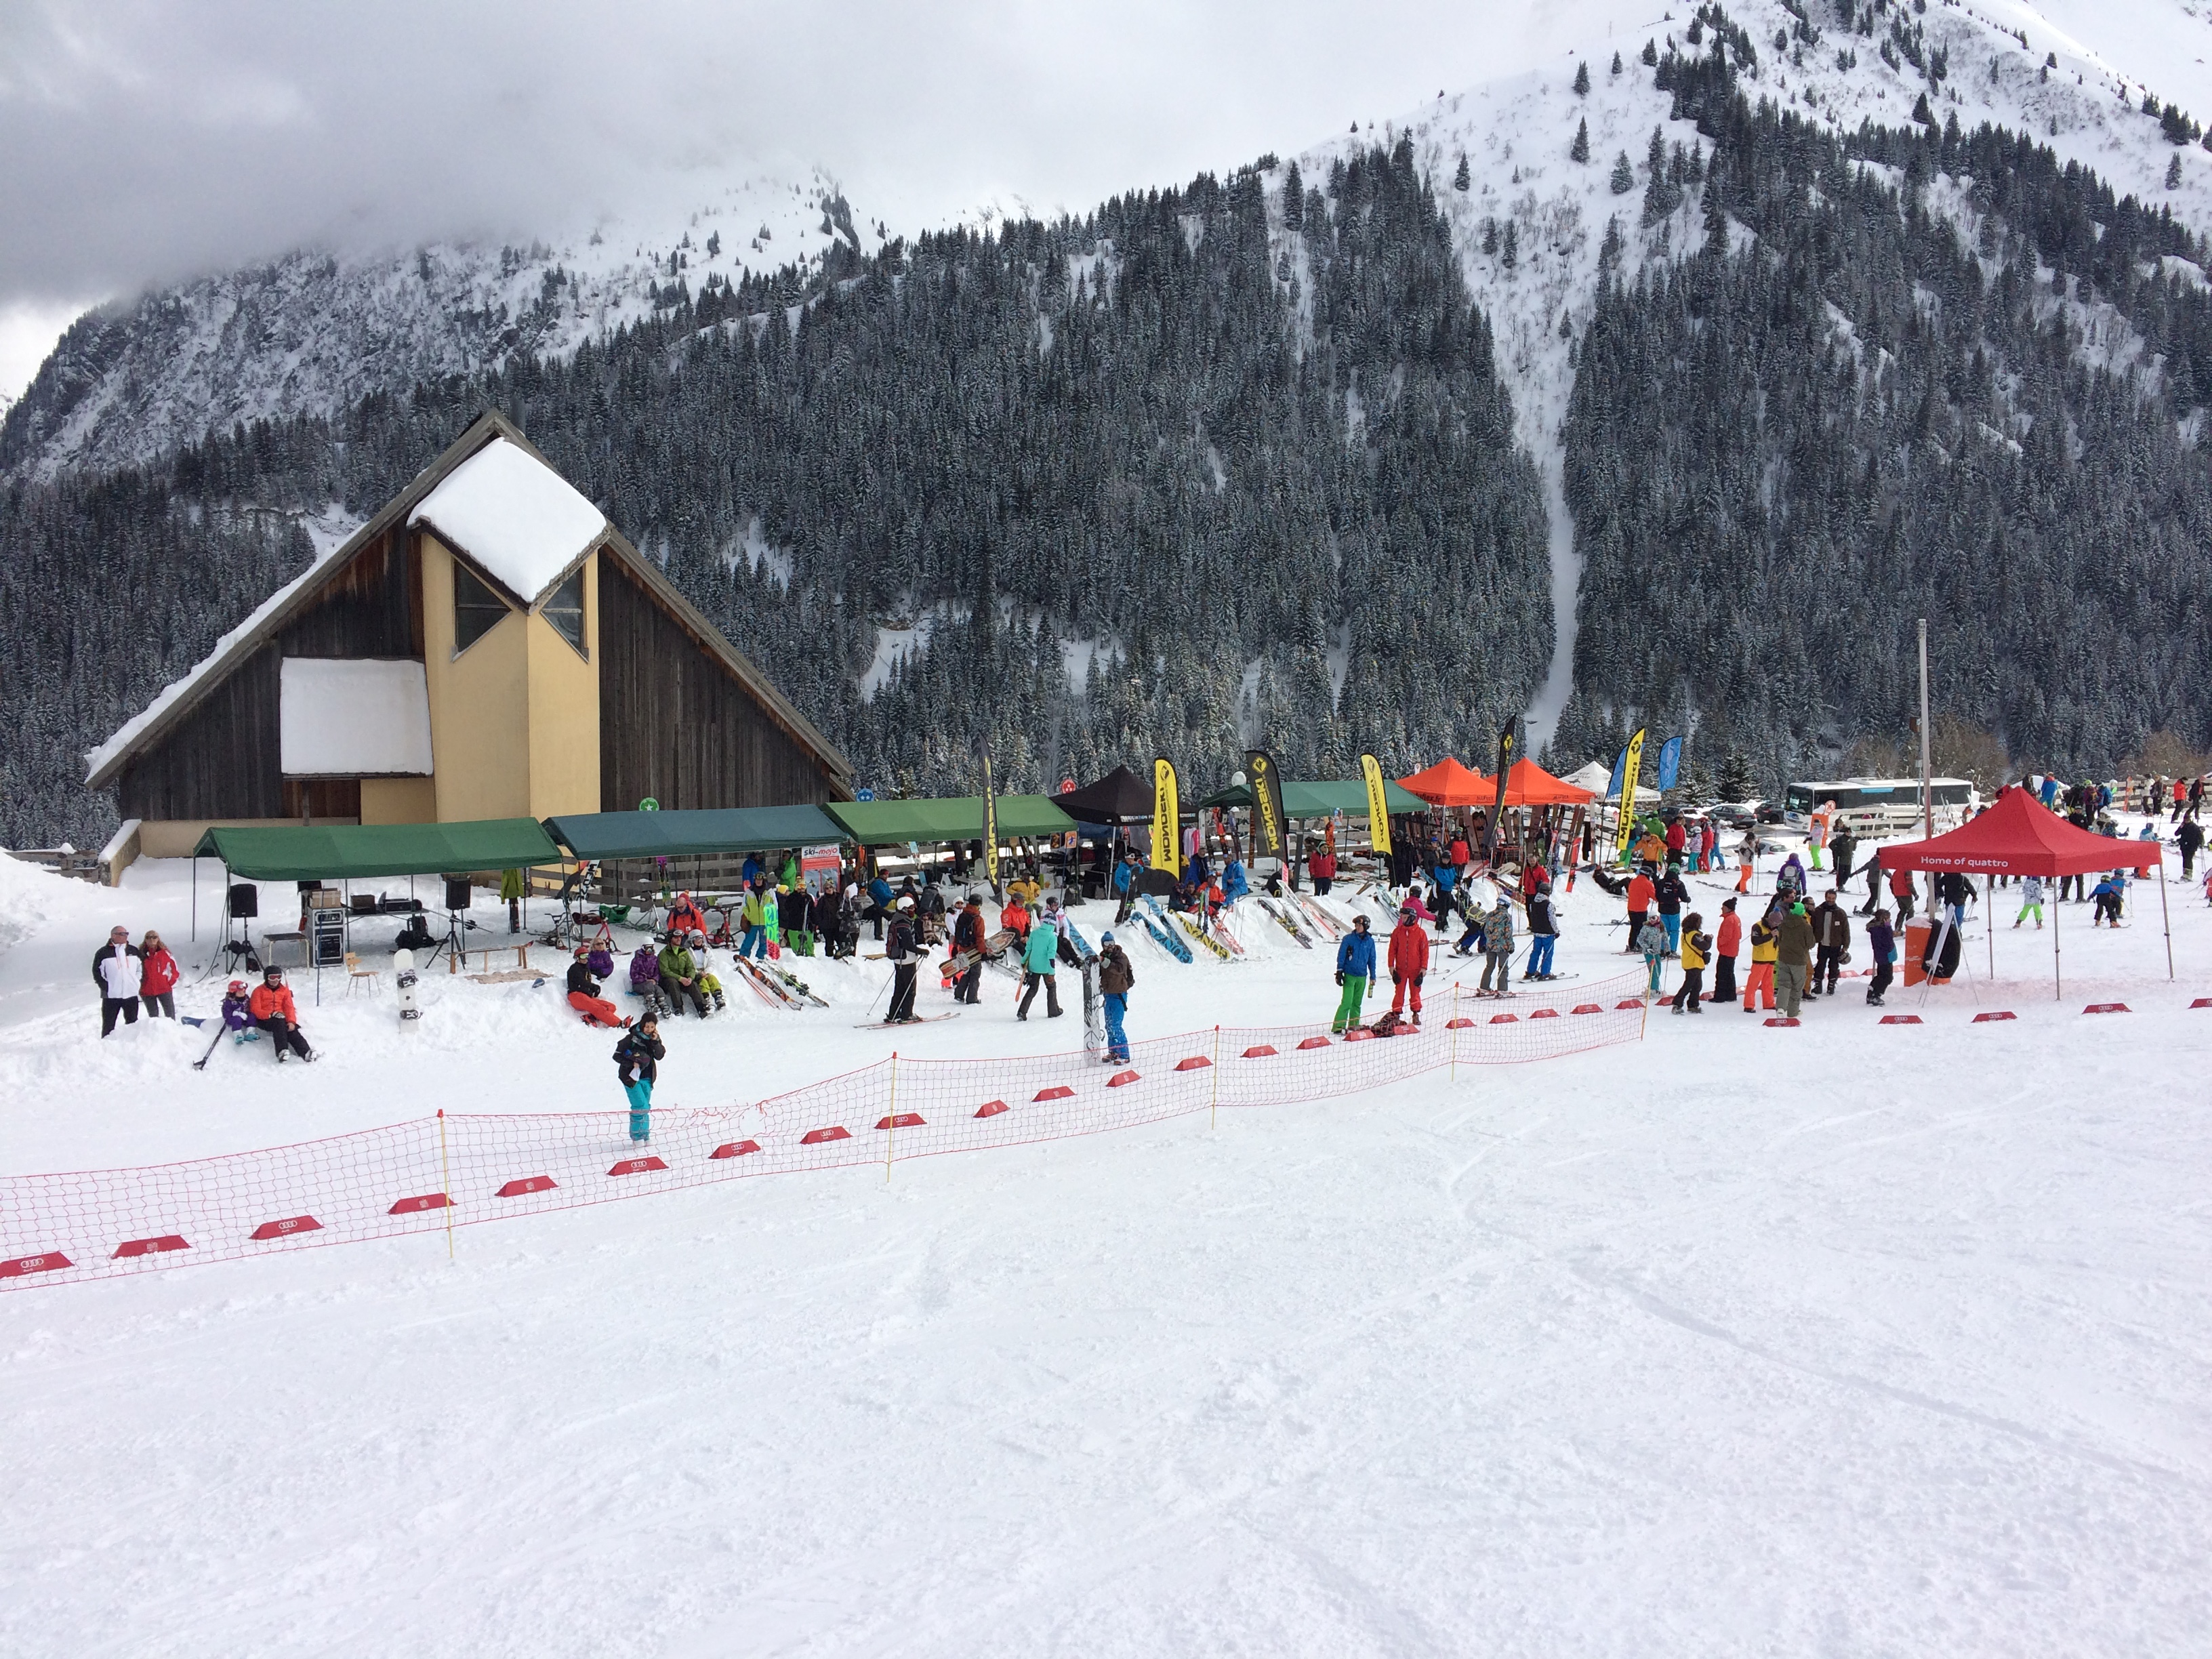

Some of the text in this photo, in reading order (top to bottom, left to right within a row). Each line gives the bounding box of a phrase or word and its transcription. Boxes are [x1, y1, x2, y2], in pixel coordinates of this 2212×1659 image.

[804, 847, 838, 856] ski-mojo
[1921, 856, 2009, 867] Home of quattro
